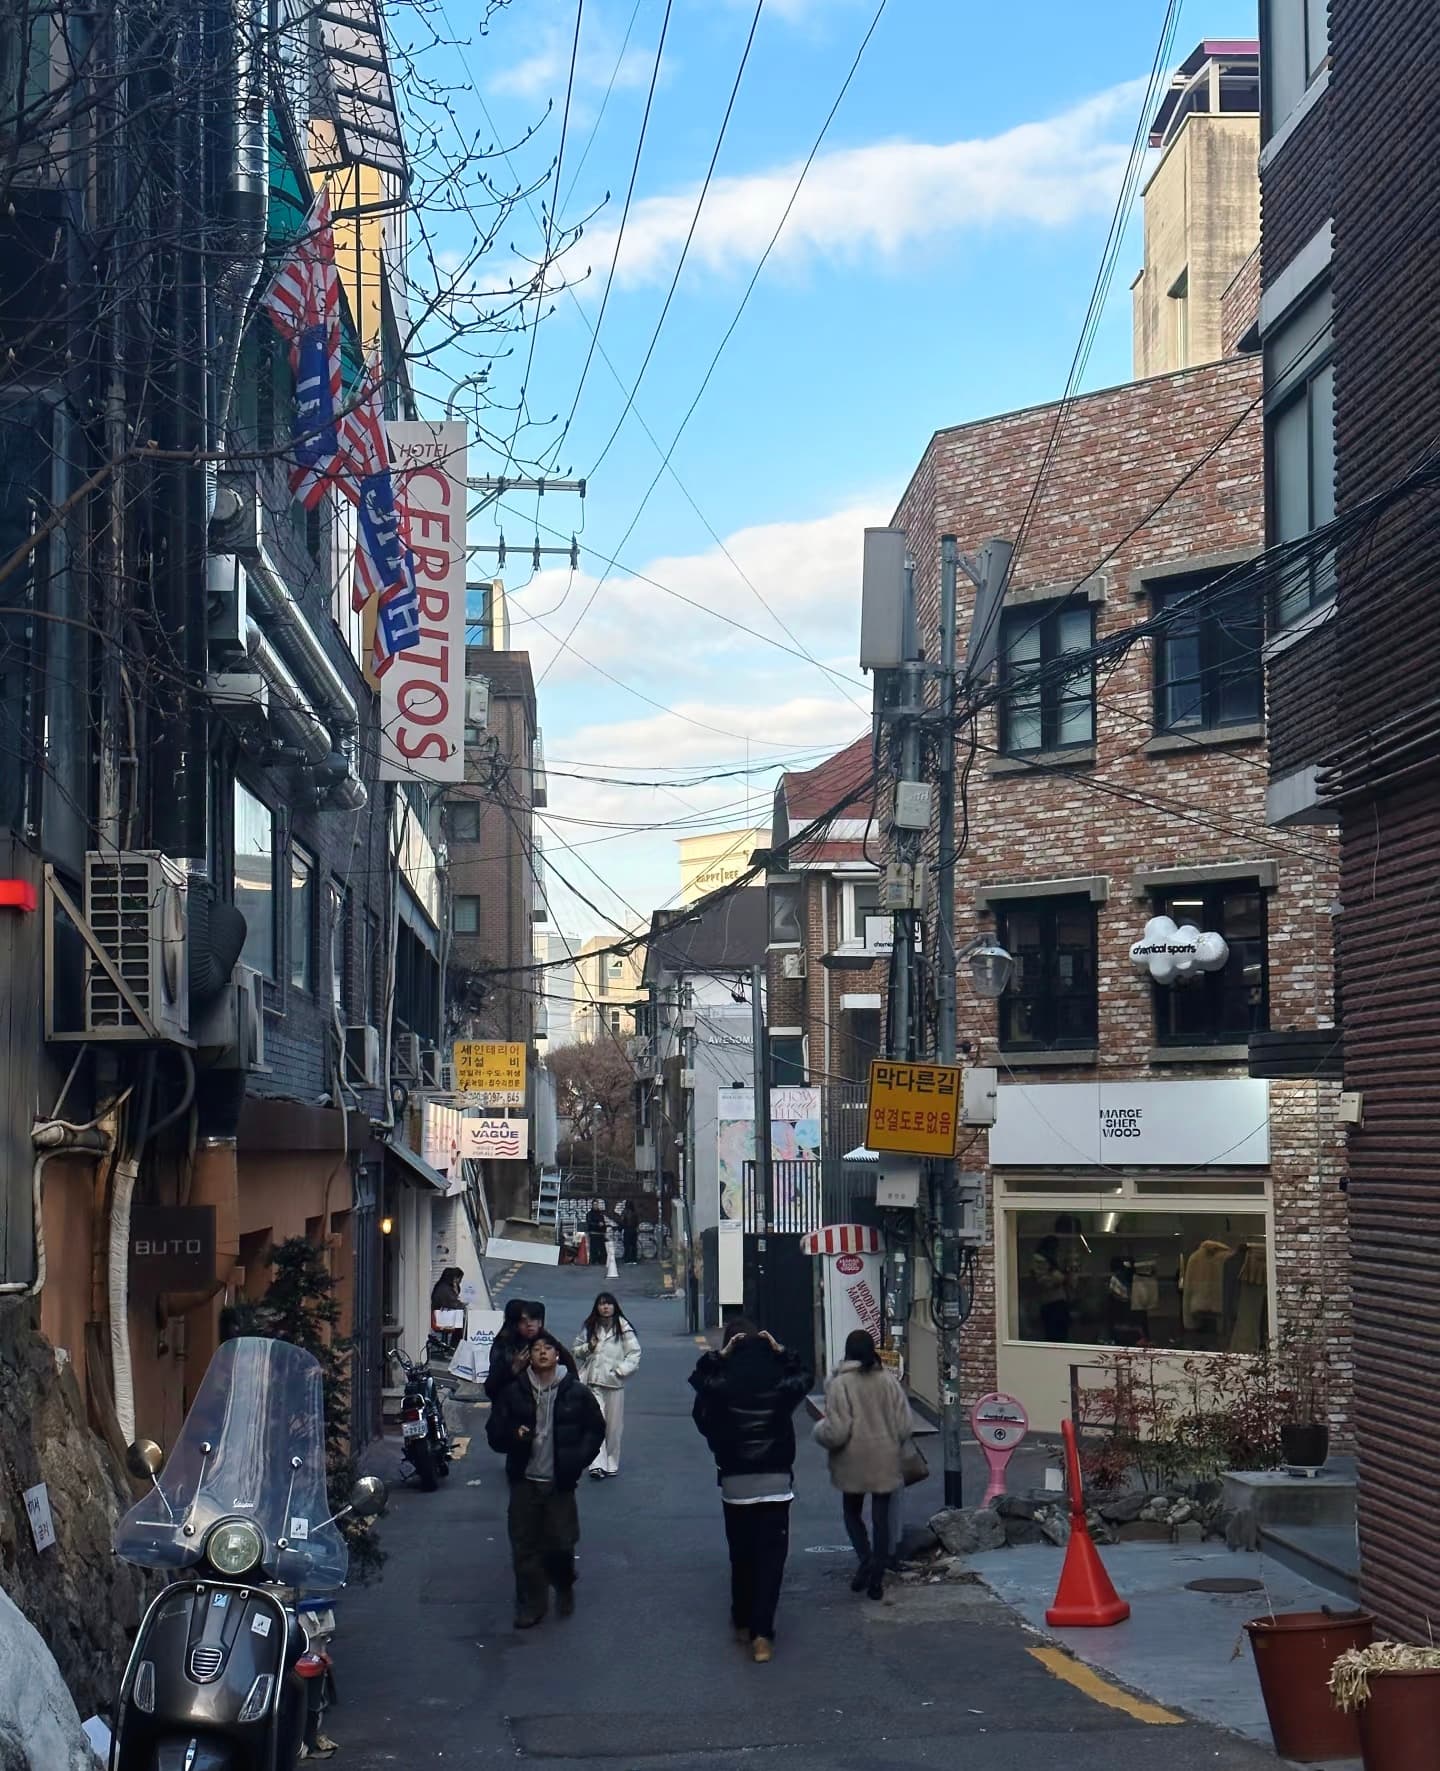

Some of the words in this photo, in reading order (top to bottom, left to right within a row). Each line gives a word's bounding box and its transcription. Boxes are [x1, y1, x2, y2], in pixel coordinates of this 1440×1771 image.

[400, 443, 448, 458] HOTEL
[396, 463, 450, 763] CERRITOS
[1133, 944, 1167, 955] chemical
[1167, 944, 1197, 955] sports
[877, 1068, 955, 1095] 막다른길
[1100, 1109, 1143, 1118] MARGE
[480, 1121, 509, 1129] ALA
[874, 1108, 951, 1135] 연결도로없음
[1105, 1119, 1137, 1128] SHER
[471, 1130, 519, 1139] VAGUE
[1102, 1128, 1141, 1138] WOOD
[135, 1239, 201, 1255] BUTO
[856, 1280, 875, 1307] WOOD
[845, 1286, 870, 1325] MACHINE
